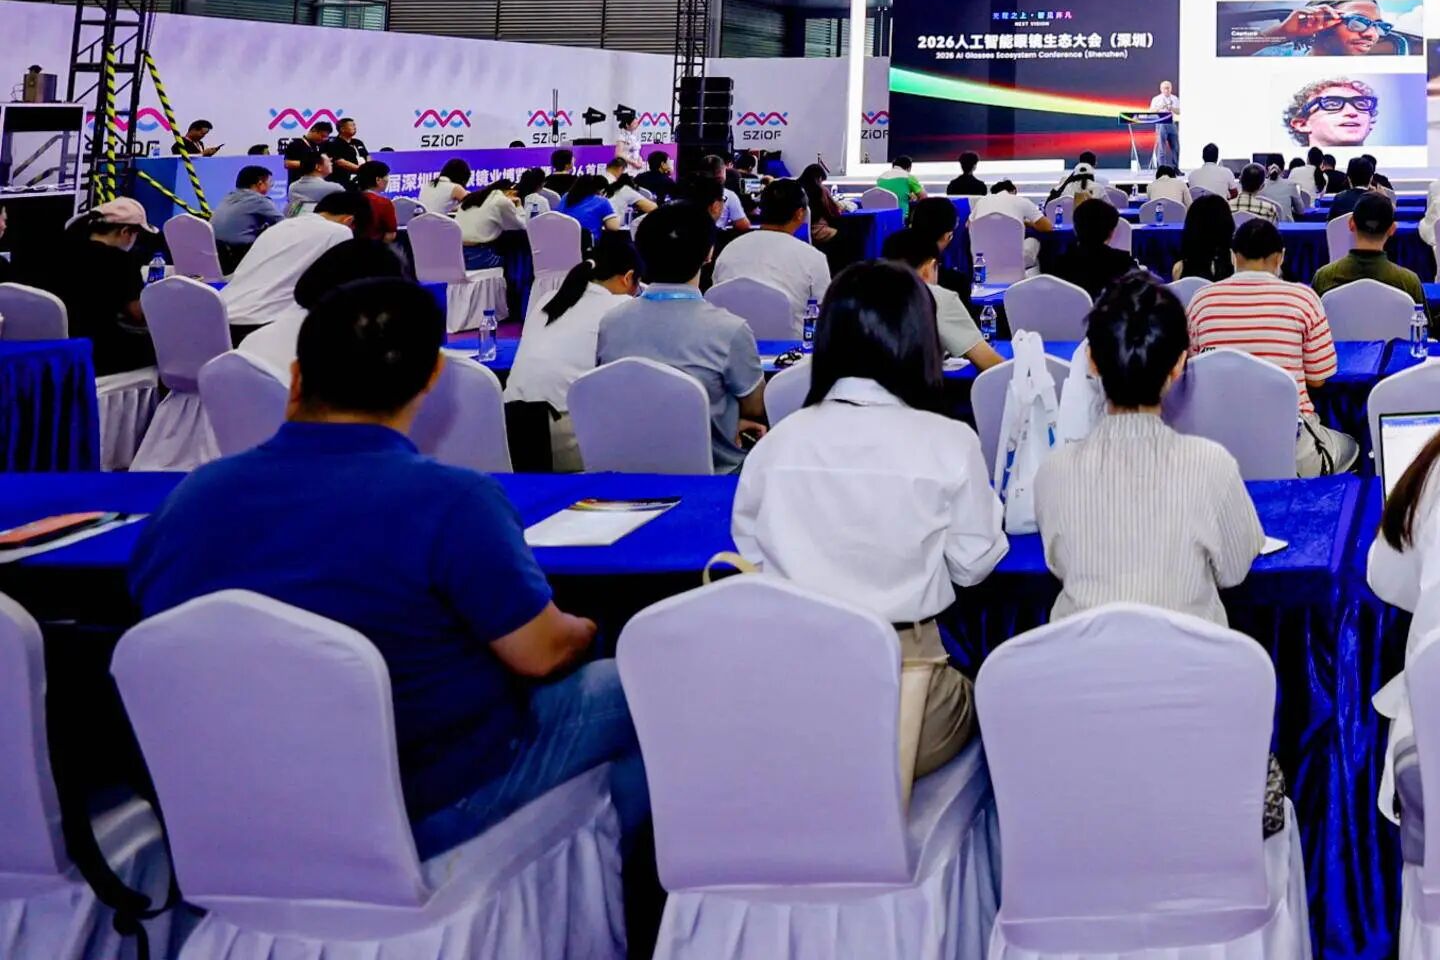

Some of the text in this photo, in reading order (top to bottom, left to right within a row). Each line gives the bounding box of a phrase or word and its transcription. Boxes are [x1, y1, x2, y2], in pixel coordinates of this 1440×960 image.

[965, 51, 995, 59] Glasses
[996, 50, 1037, 60] Ecosystem
[1038, 50, 1083, 59] Conference
[1084, 49, 1128, 59] (Shenzhen)
[742, 130, 782, 140] SZiOF
[420, 134, 465, 148] SZiOF
